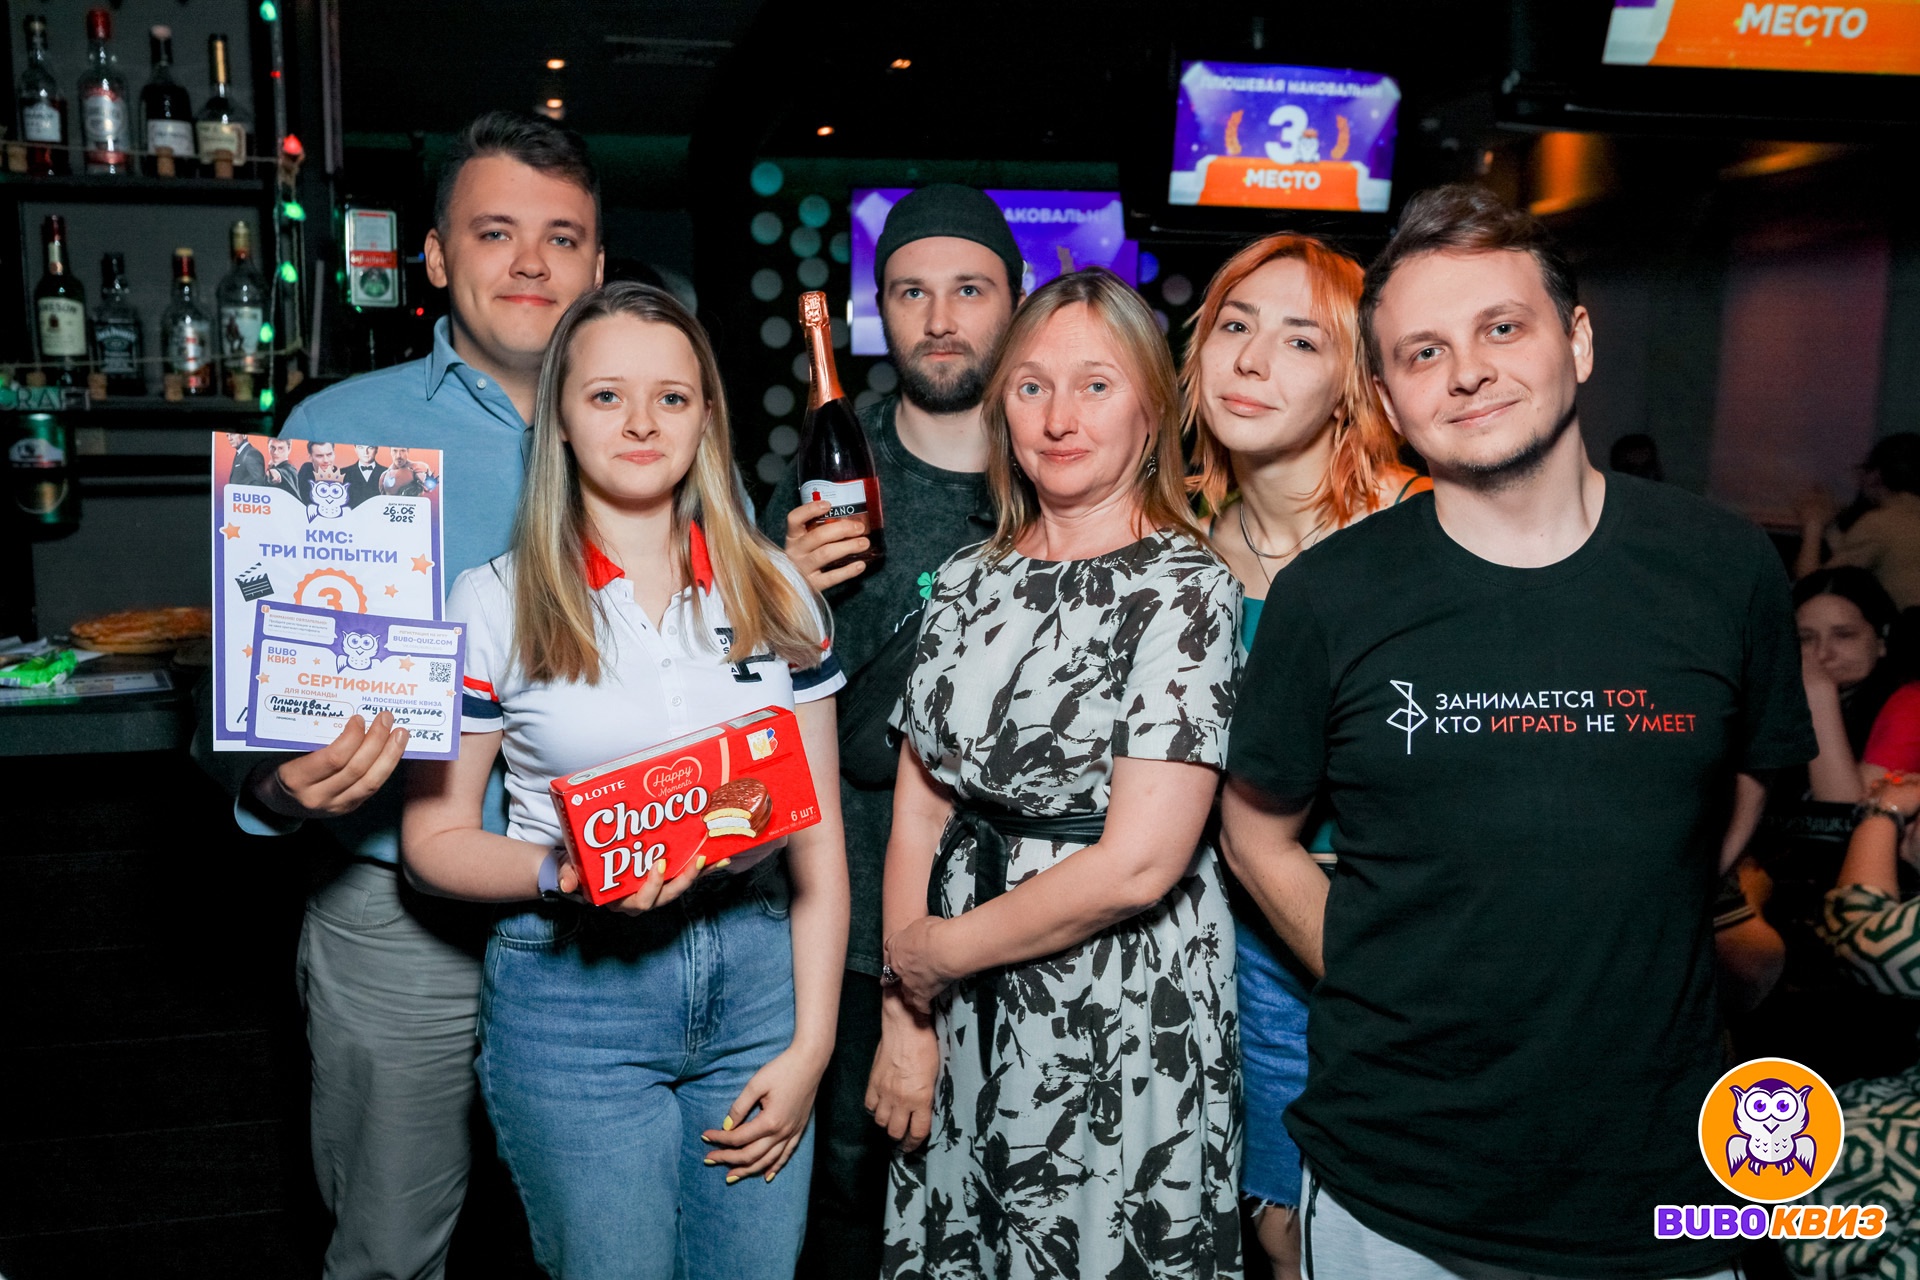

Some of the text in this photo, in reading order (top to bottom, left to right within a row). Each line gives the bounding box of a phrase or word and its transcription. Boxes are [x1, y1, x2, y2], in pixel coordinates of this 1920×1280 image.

[1738, 2, 1869, 39] МЕСТО
[1264, 104, 1309, 165] 3
[1246, 168, 1322, 191] МЕСТО
[1003, 207, 1103, 224] АКОВАЛЬН
[233, 492, 271, 504] BUBO
[233, 503, 271, 515] КВИЗ
[390, 514, 414, 523] 2025
[305, 529, 353, 544] КМС:
[259, 543, 398, 564] ТРИ ПОПЫТКИ
[318, 587, 344, 612] 3
[393, 635, 453, 646] BUBO-QUIZ.COM
[267, 646, 297, 656] BUBO
[267, 655, 297, 665] КВИЗ
[297, 672, 418, 697] СЕРТИФИКАТ
[301, 690, 338, 698] КОМАНДЫ
[373, 697, 418, 706] ПОСЕЩЕНИЕ
[1435, 689, 1656, 710] ЗАНИМАЕТСЯ ТОТ,
[1435, 713, 1697, 733] КТО ИГРАТЬ НЕ УМЕЕТ
[652, 765, 694, 787] Happy
[584, 779, 627, 801] LOTTE
[658, 779, 692, 797] Moments
[583, 786, 708, 849] Choco
[791, 810, 798, 822] 6
[599, 840, 666, 892] Pie
